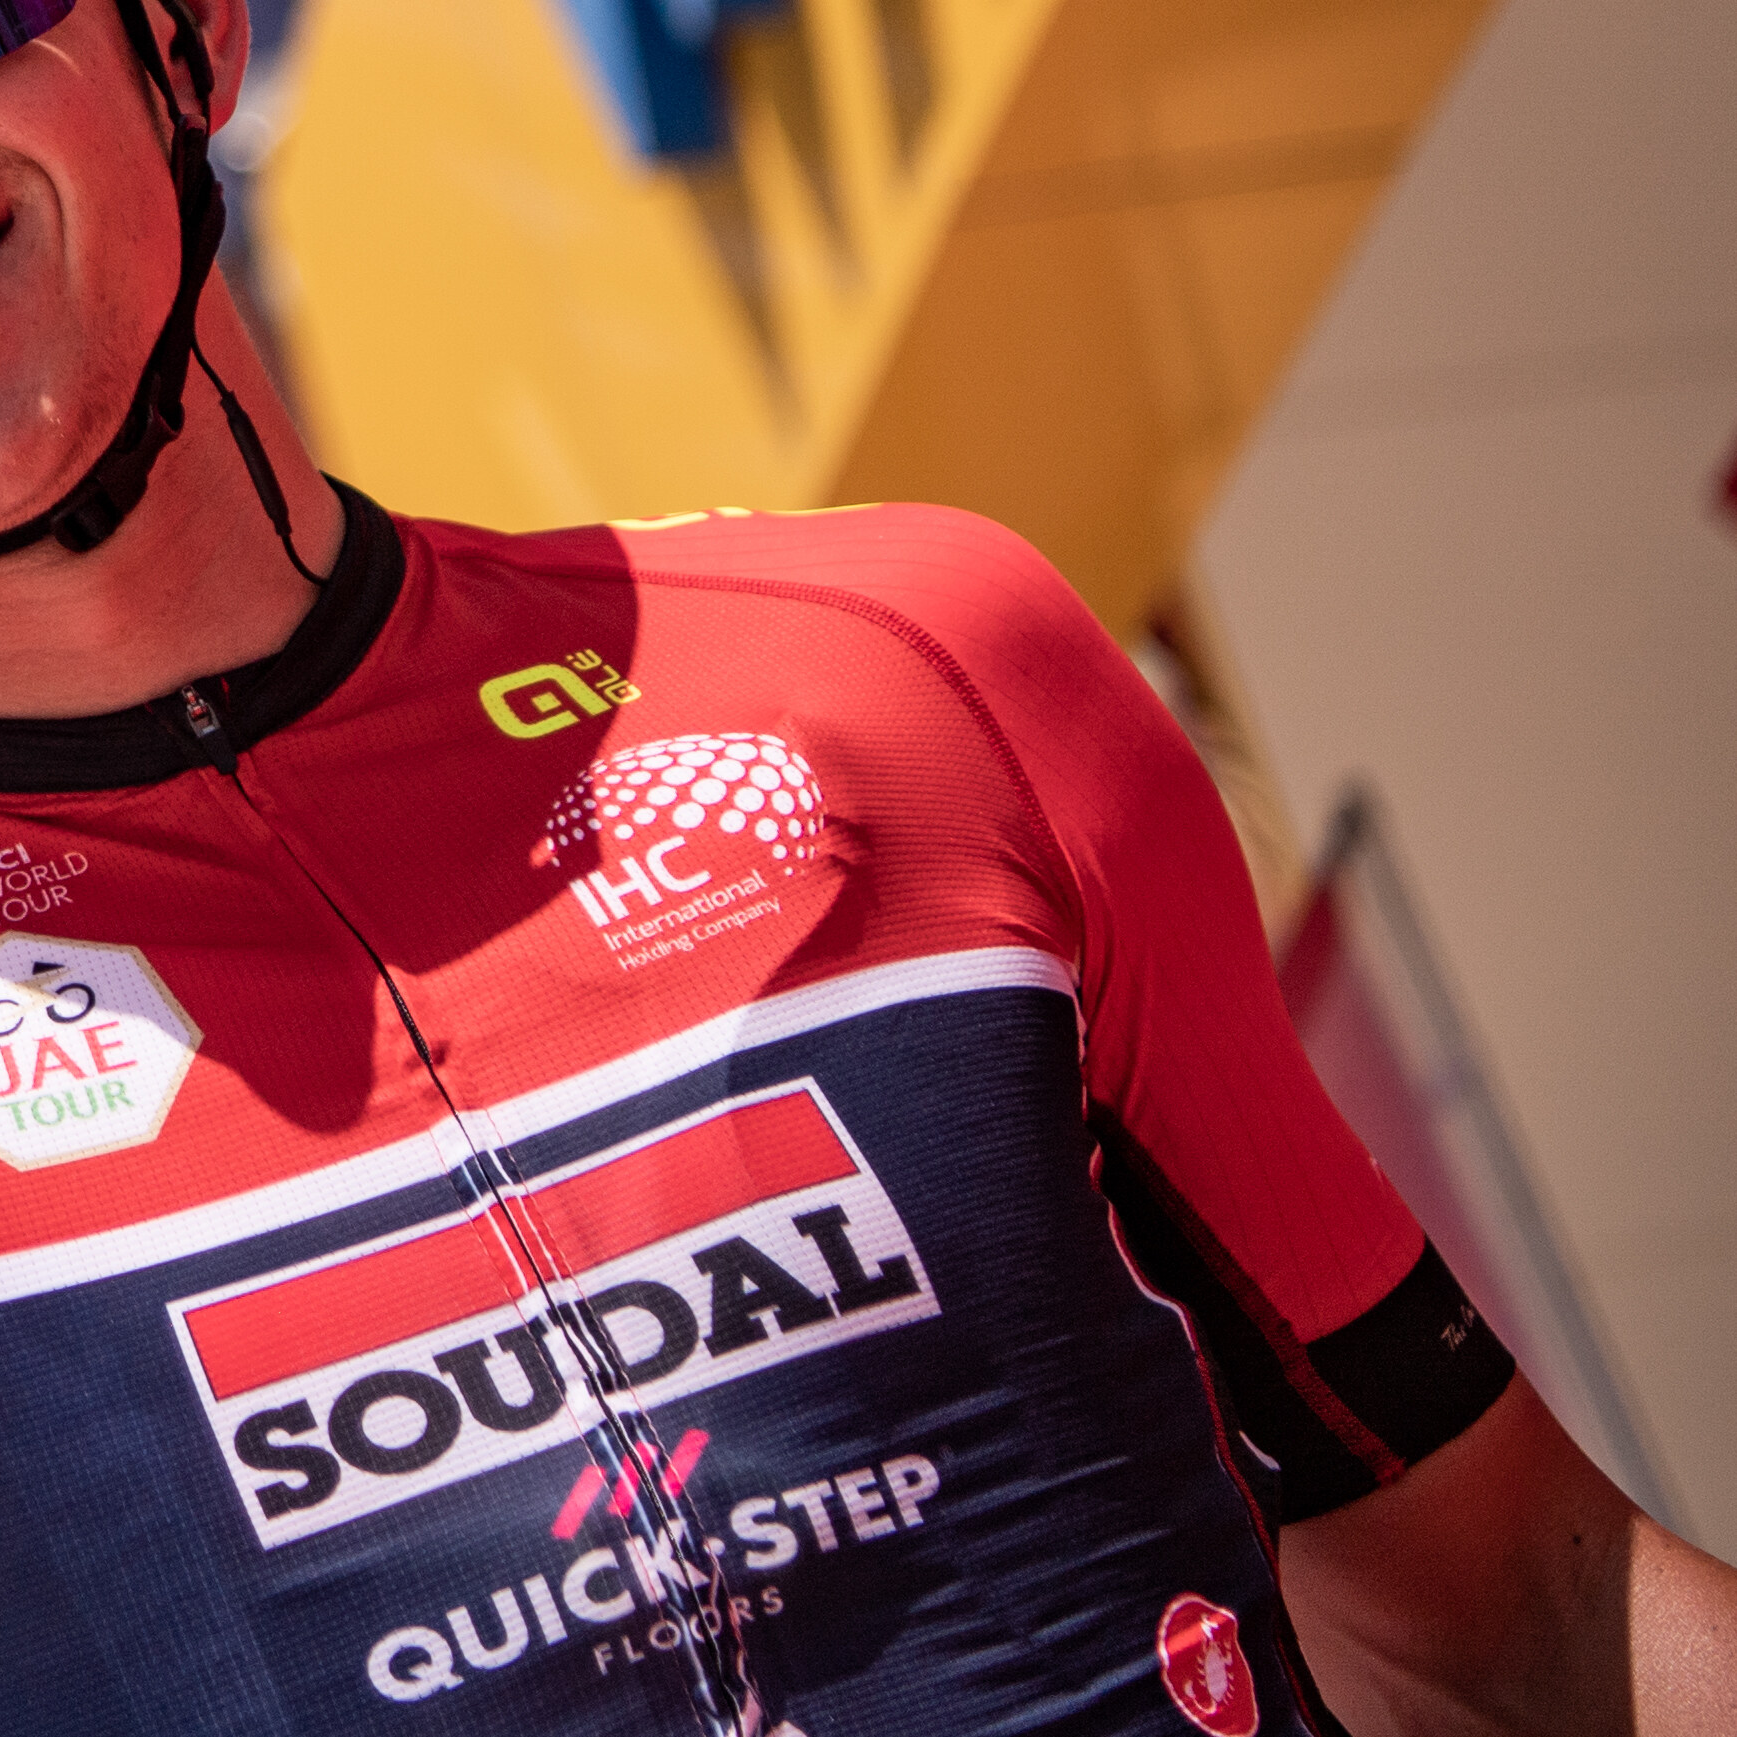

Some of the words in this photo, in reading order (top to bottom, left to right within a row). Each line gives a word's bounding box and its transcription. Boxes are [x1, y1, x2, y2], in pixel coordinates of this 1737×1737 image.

[570, 835, 712, 928] IHC
[603, 868, 769, 952] International
[618, 934, 696, 972] Holding
[692, 896, 782, 941] Company
[232, 1204, 924, 1521] SOUDAL
[592, 1584, 785, 1677] FLOORS
